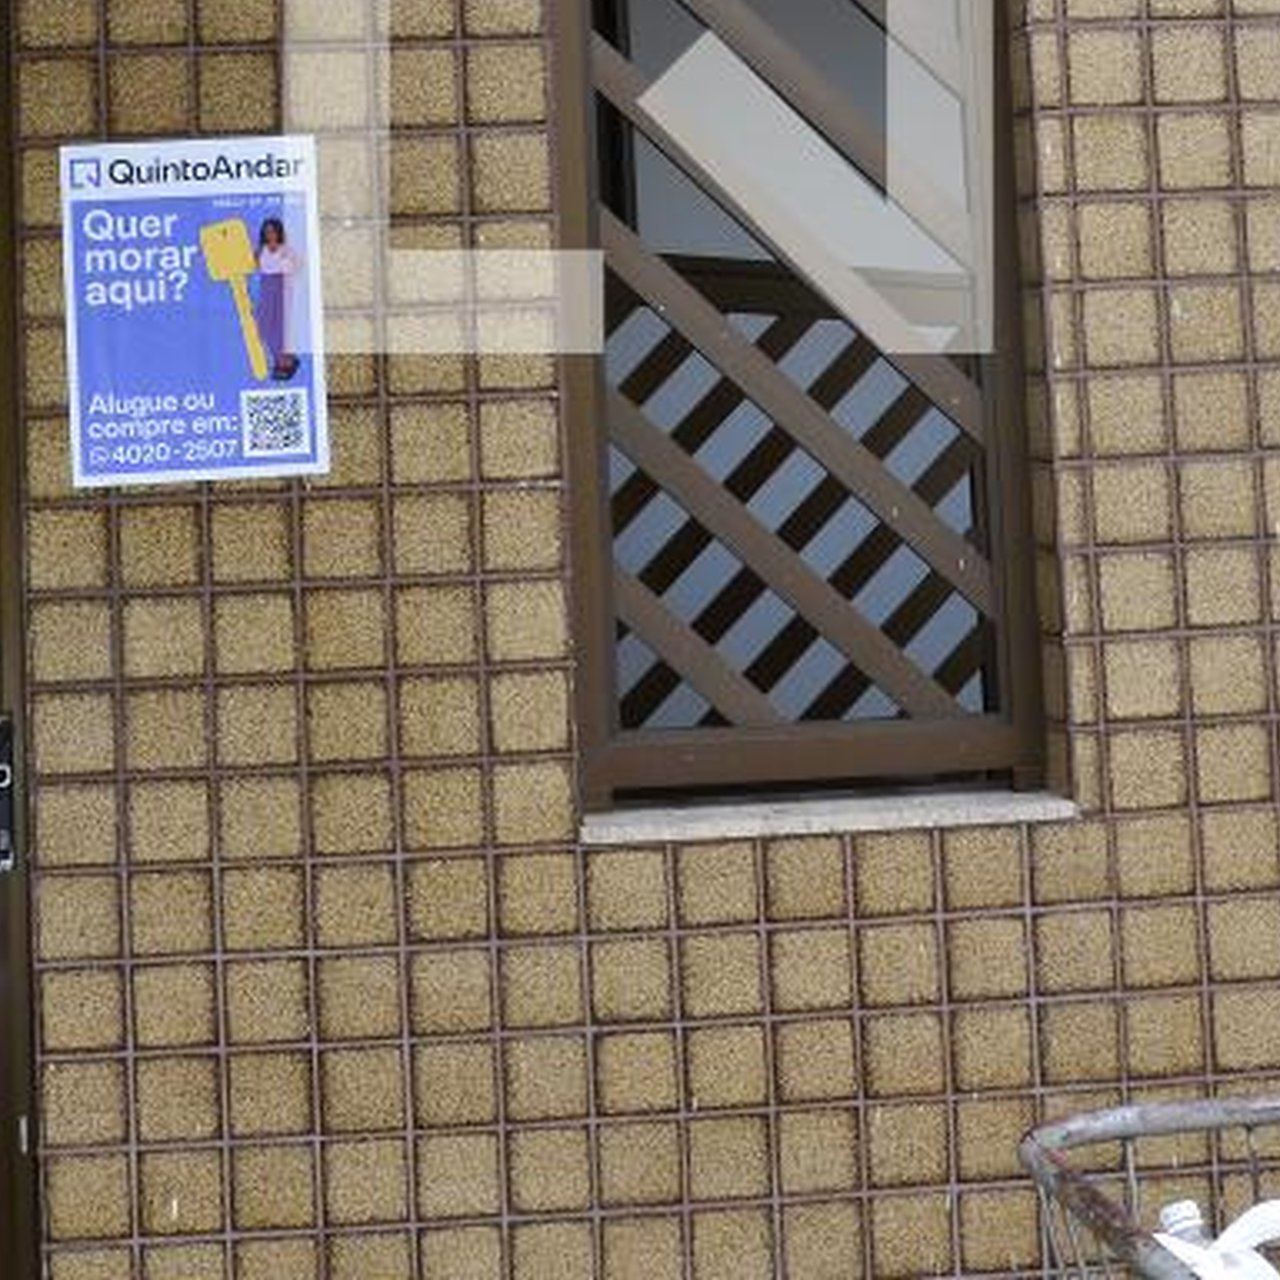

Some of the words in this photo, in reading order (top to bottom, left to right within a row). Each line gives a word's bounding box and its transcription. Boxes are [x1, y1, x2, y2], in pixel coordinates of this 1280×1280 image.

[109, 155, 303, 185] QuintoAndar
[83, 209, 178, 241] Quer
[85, 243, 198, 272] morar
[85, 271, 188, 311] aqui?
[89, 393, 177, 416] Alugue
[184, 393, 215, 411] ou
[88, 418, 186, 439] compre
[192, 416, 238, 434] em:
